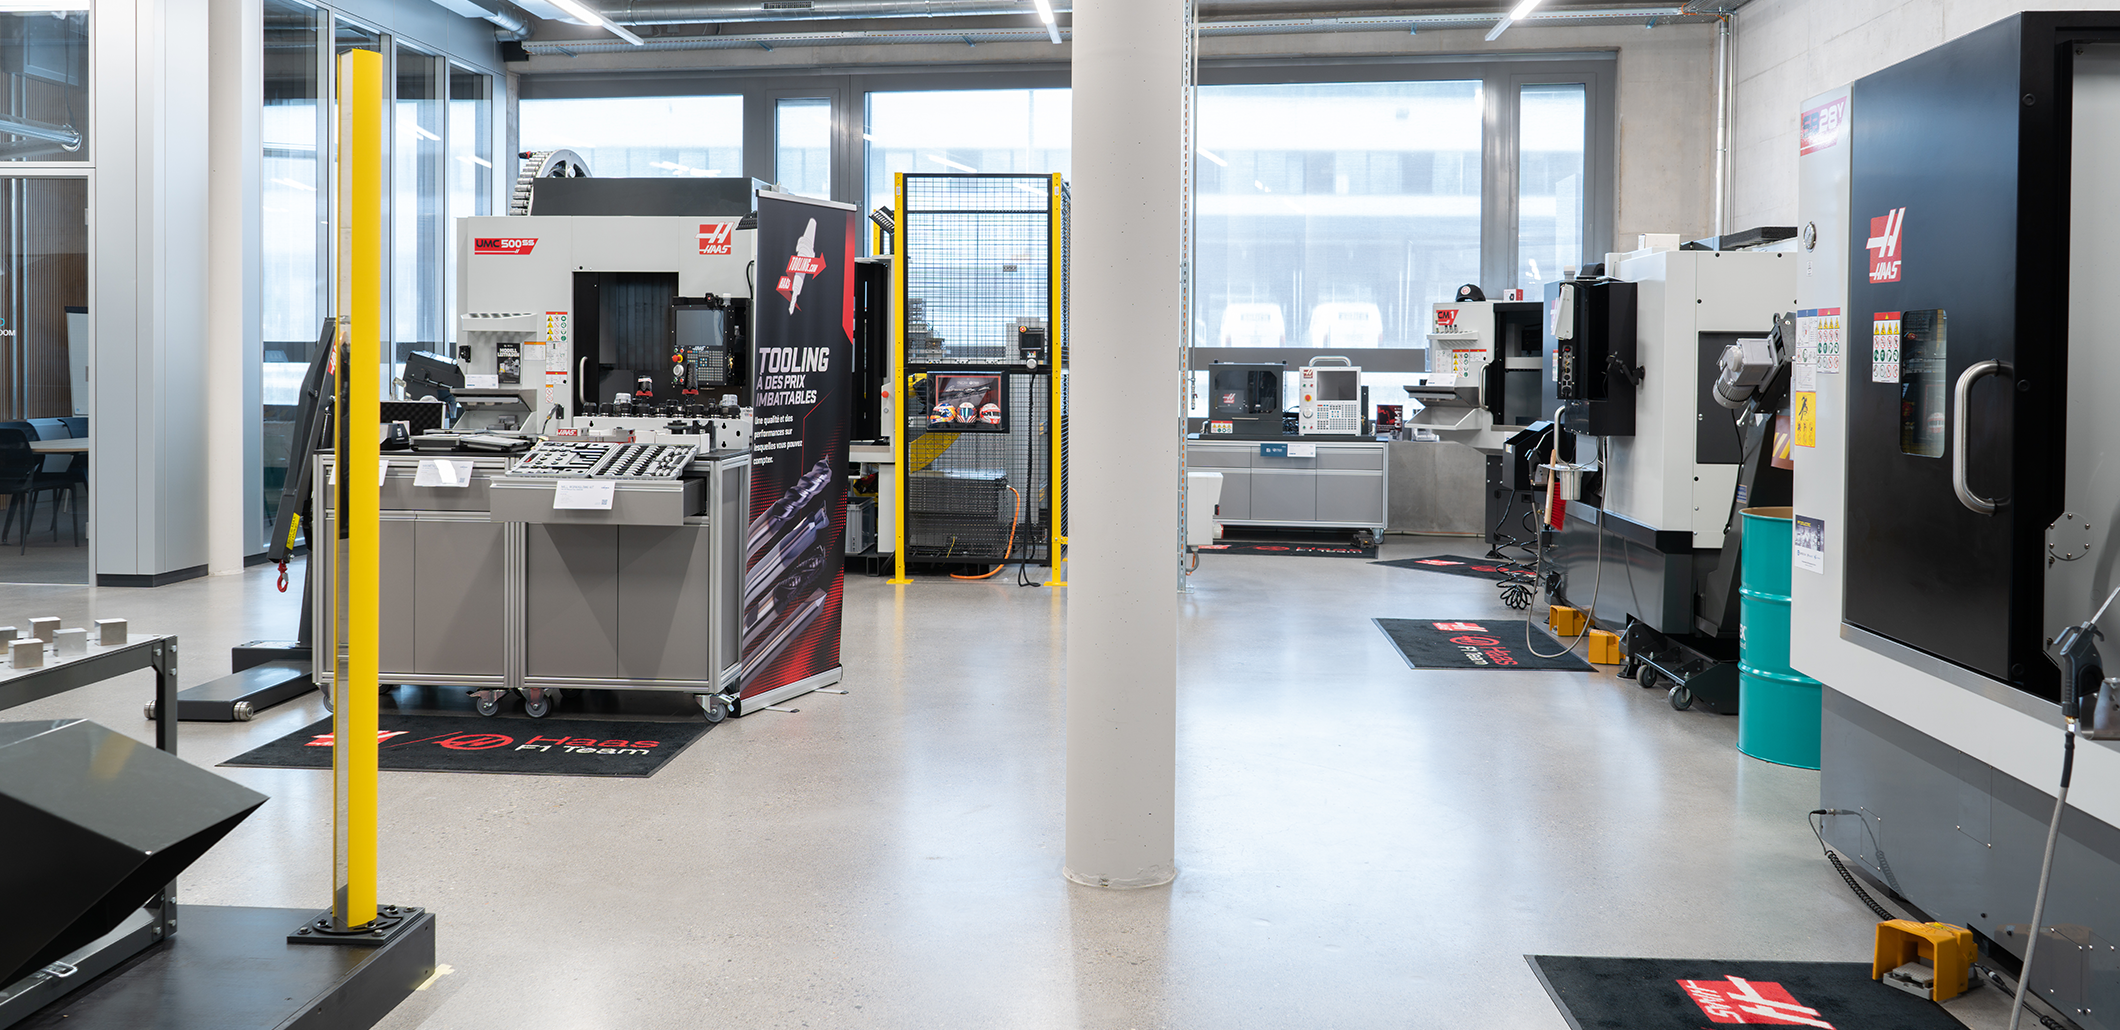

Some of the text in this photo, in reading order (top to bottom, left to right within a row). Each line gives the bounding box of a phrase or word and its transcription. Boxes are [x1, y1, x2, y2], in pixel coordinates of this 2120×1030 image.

[699, 244, 732, 254] HAAS
[1869, 260, 1902, 281] HAAS
[778, 277, 791, 289] HAAS
[759, 346, 830, 374] TOOLING
[756, 371, 806, 391] À DES PRIX
[756, 389, 818, 408] IMBATTABLES
[764, 414, 780, 426] qualité
[780, 415, 785, 423] et
[785, 414, 794, 422] des
[558, 428, 577, 436] HAAS
[754, 428, 793, 440] performances sur
[753, 440, 803, 453] lesquelles vous pouvez
[524, 734, 661, 749] Haas
[514, 744, 651, 756] F1 Team
[1686, 979, 1747, 1025] HAAS
